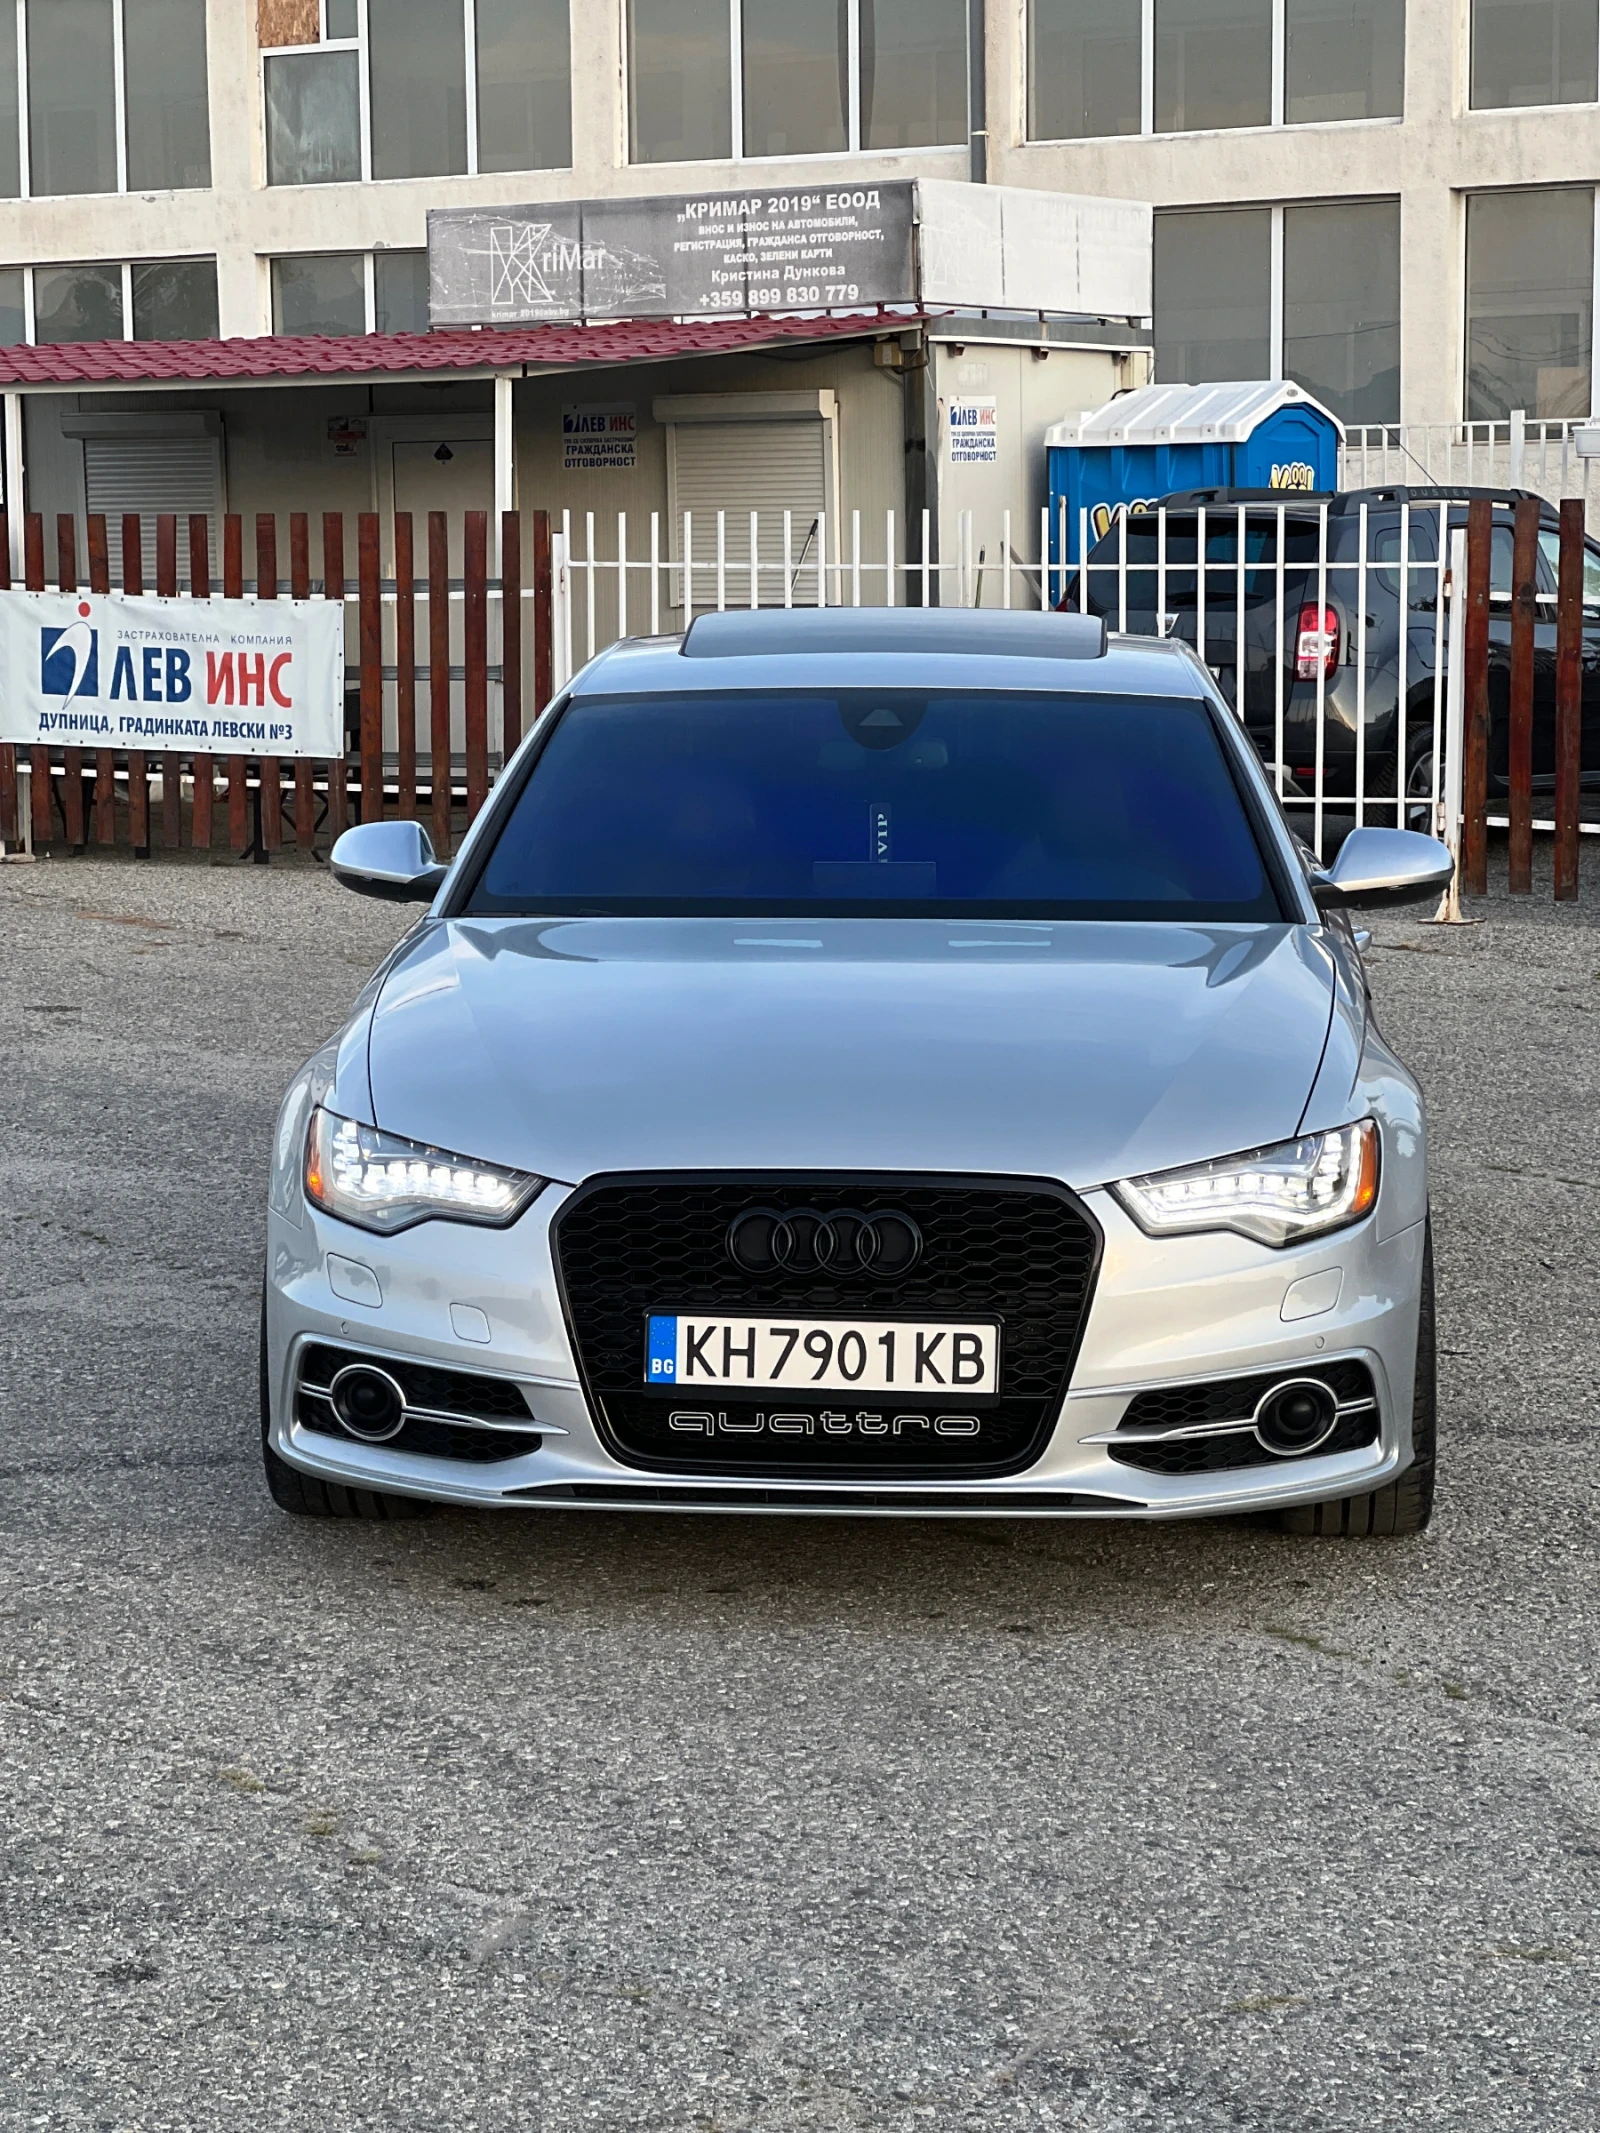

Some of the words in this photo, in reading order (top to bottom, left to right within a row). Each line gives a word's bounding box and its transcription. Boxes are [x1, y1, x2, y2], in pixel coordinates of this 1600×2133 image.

[826, 190, 880, 210] ЕООД
[698, 224, 725, 235] ВНОС
[727, 223, 735, 233] И
[737, 221, 770, 233] ИЗНОС
[772, 220, 786, 231] НА
[788, 215, 858, 230] АВТОМОБИЛИ,
[674, 238, 745, 253] РЕГИСТРАЦИЯ,
[809, 229, 885, 243] ОТГОВОРНОСТ,
[723, 252, 758, 264] КАСКО,
[760, 250, 799, 262] ЗЕЛЕНИ
[801, 248, 833, 260] КАРТИ
[711, 269, 780, 286] Кристина
[783, 265, 845, 281] Дункова
[699, 290, 743, 308] +359
[748, 287, 781, 305] 899
[786, 286, 820, 303] 830
[825, 284, 859, 301] 779
[609, 415, 636, 432] ИНС
[566, 444, 634, 456] ГРАЖДАНСКА
[952, 438, 995, 449] ГРАЖДАНСКА
[564, 457, 636, 468] ОТГОВОРНОСТ
[951, 451, 997, 461] ОТГОВОРНОСТ
[1410, 488, 1471, 497] DUSTER
[117, 630, 220, 644] ЗАСТРАХОВАТЕЛНА
[230, 634, 293, 645] КОМПАНИЯ
[109, 645, 192, 703] ЛЕВ
[206, 651, 293, 708] ИНС
[39, 712, 114, 734] ДУПНИЦА,
[119, 716, 208, 737] ГРАДИНКАТА
[211, 721, 265, 739] ЛЕВСКИ
[269, 724, 293, 740] №3
[877, 813, 888, 855] VIP
[652, 1358, 674, 1375] BG
[669, 1410, 981, 1436] quattro
